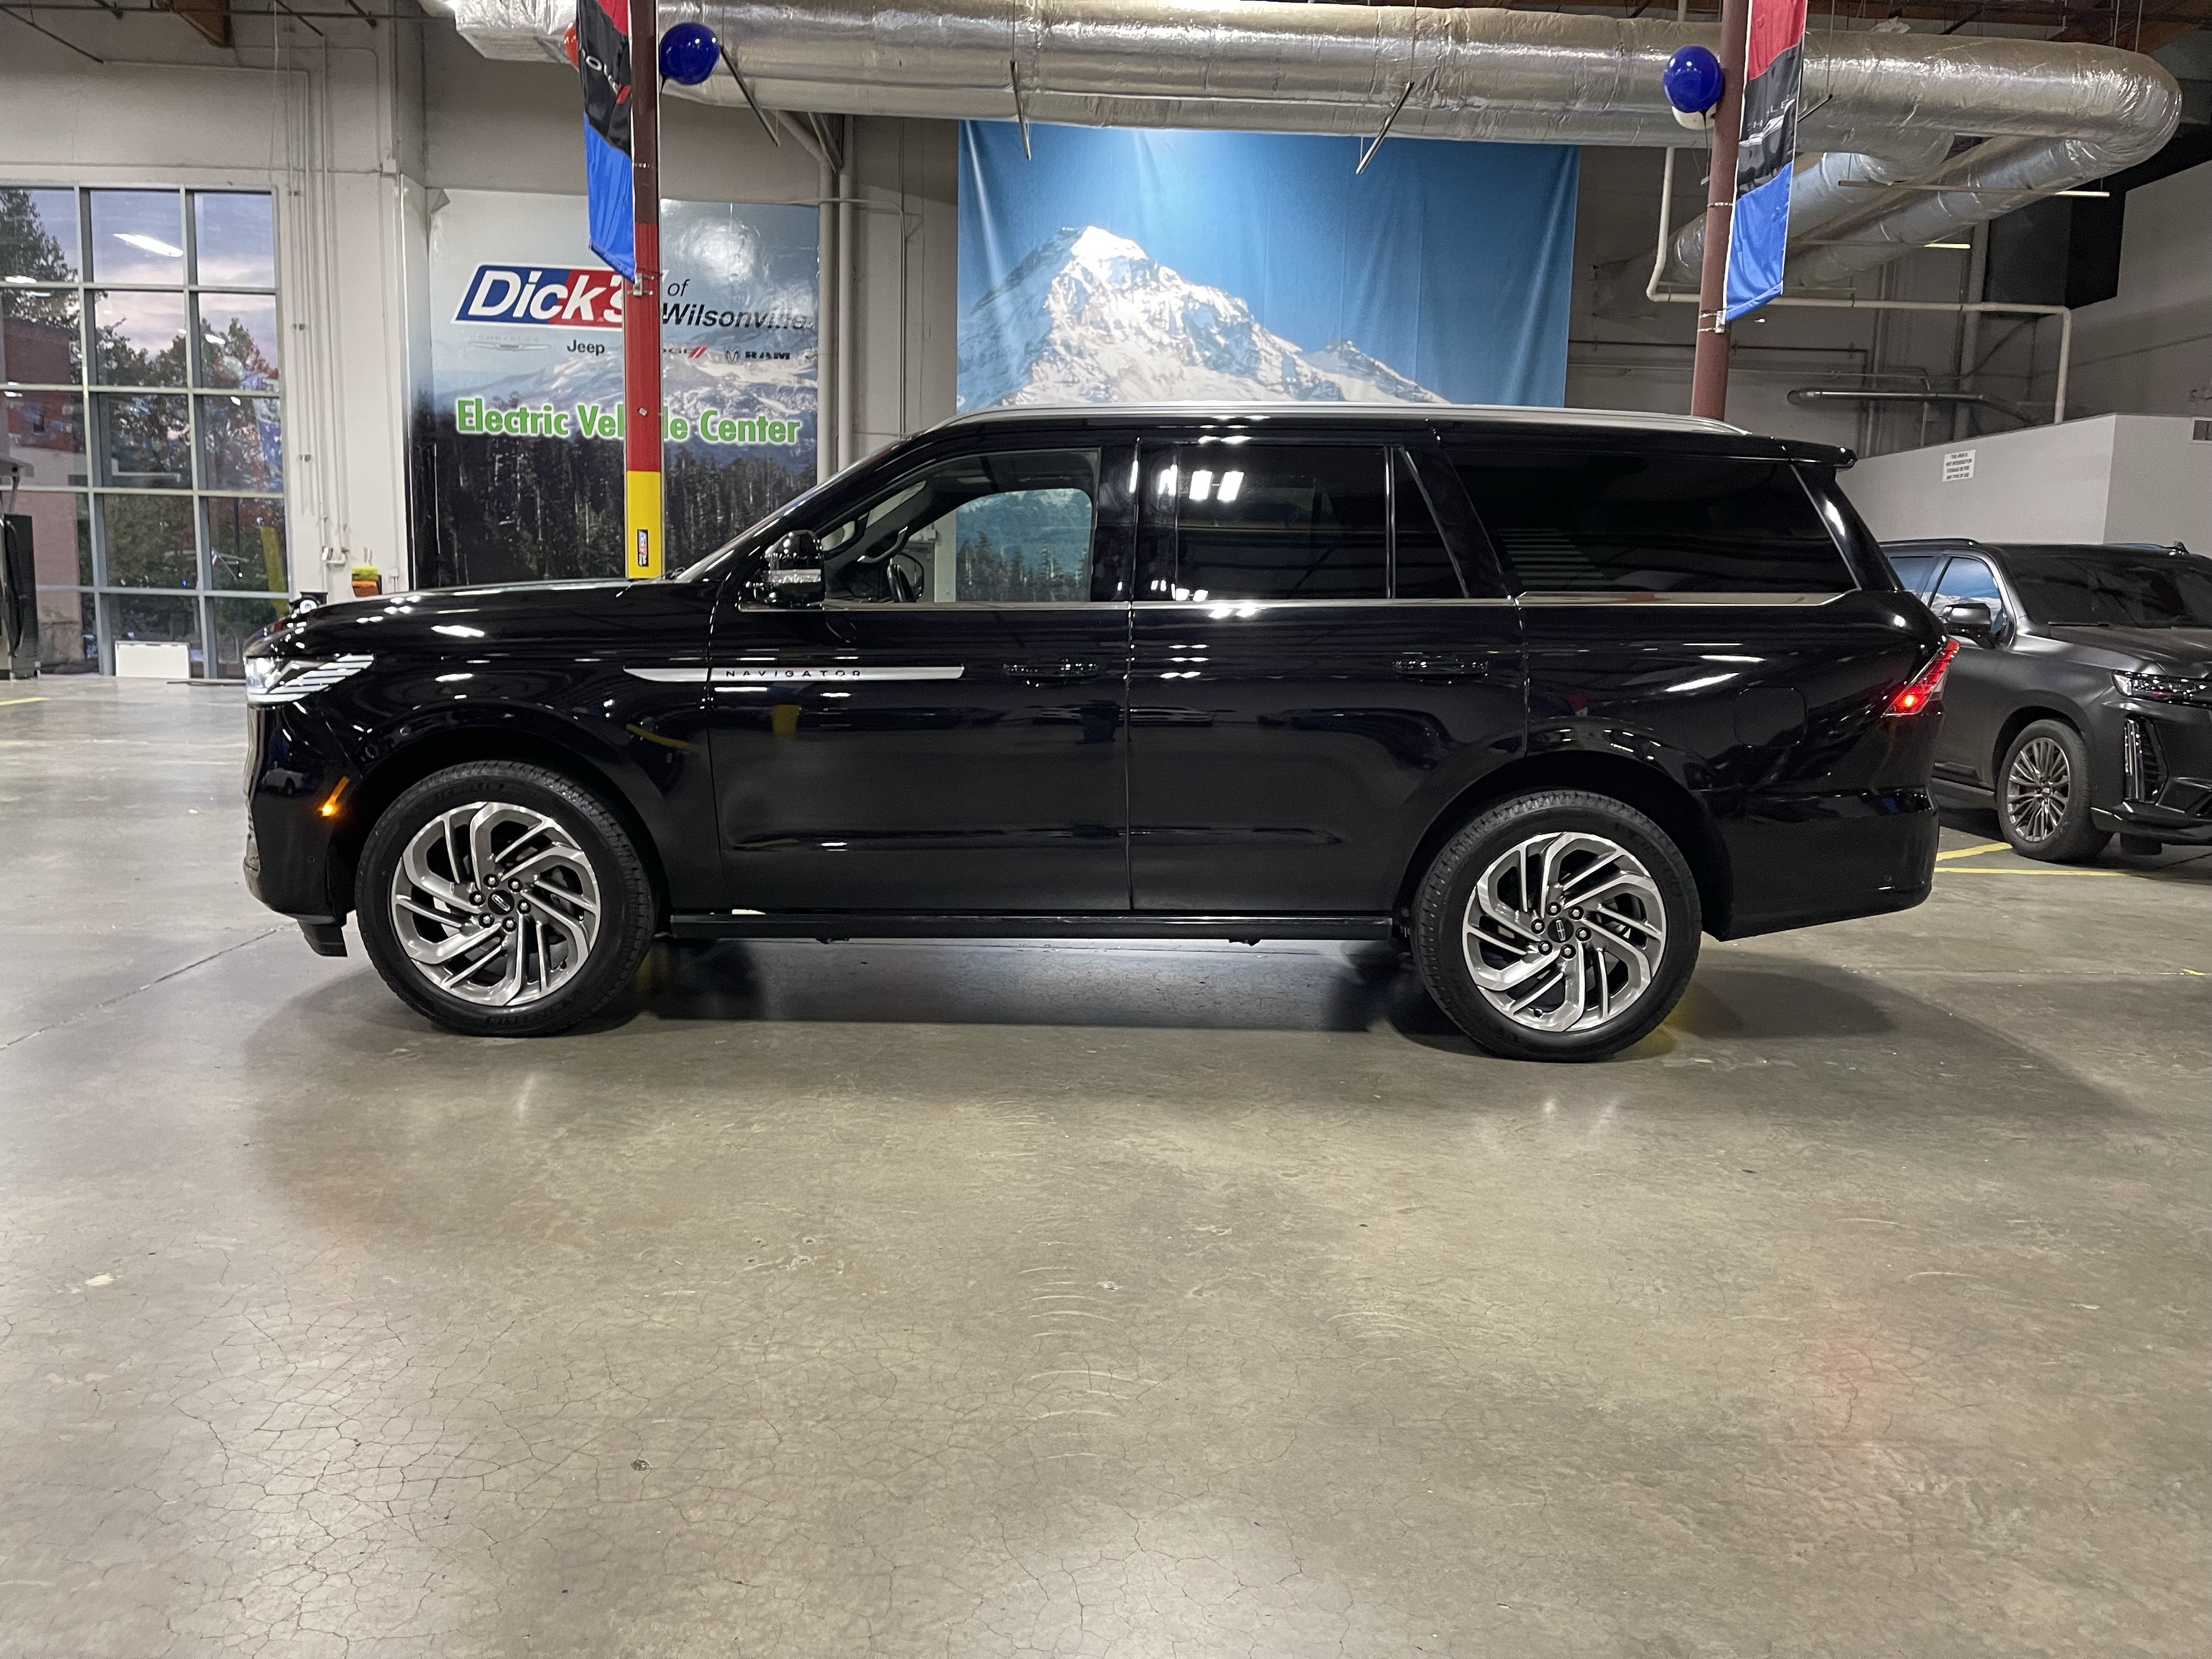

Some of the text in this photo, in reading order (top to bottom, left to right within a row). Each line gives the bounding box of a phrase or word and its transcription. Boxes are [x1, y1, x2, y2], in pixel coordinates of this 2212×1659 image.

[667, 279, 690, 297] of
[663, 302, 807, 330] Wilsonville
[567, 340, 605, 356] Jeep
[744, 351, 790, 360] RAM
[458, 398, 569, 436] Electric
[700, 410, 800, 443] Center
